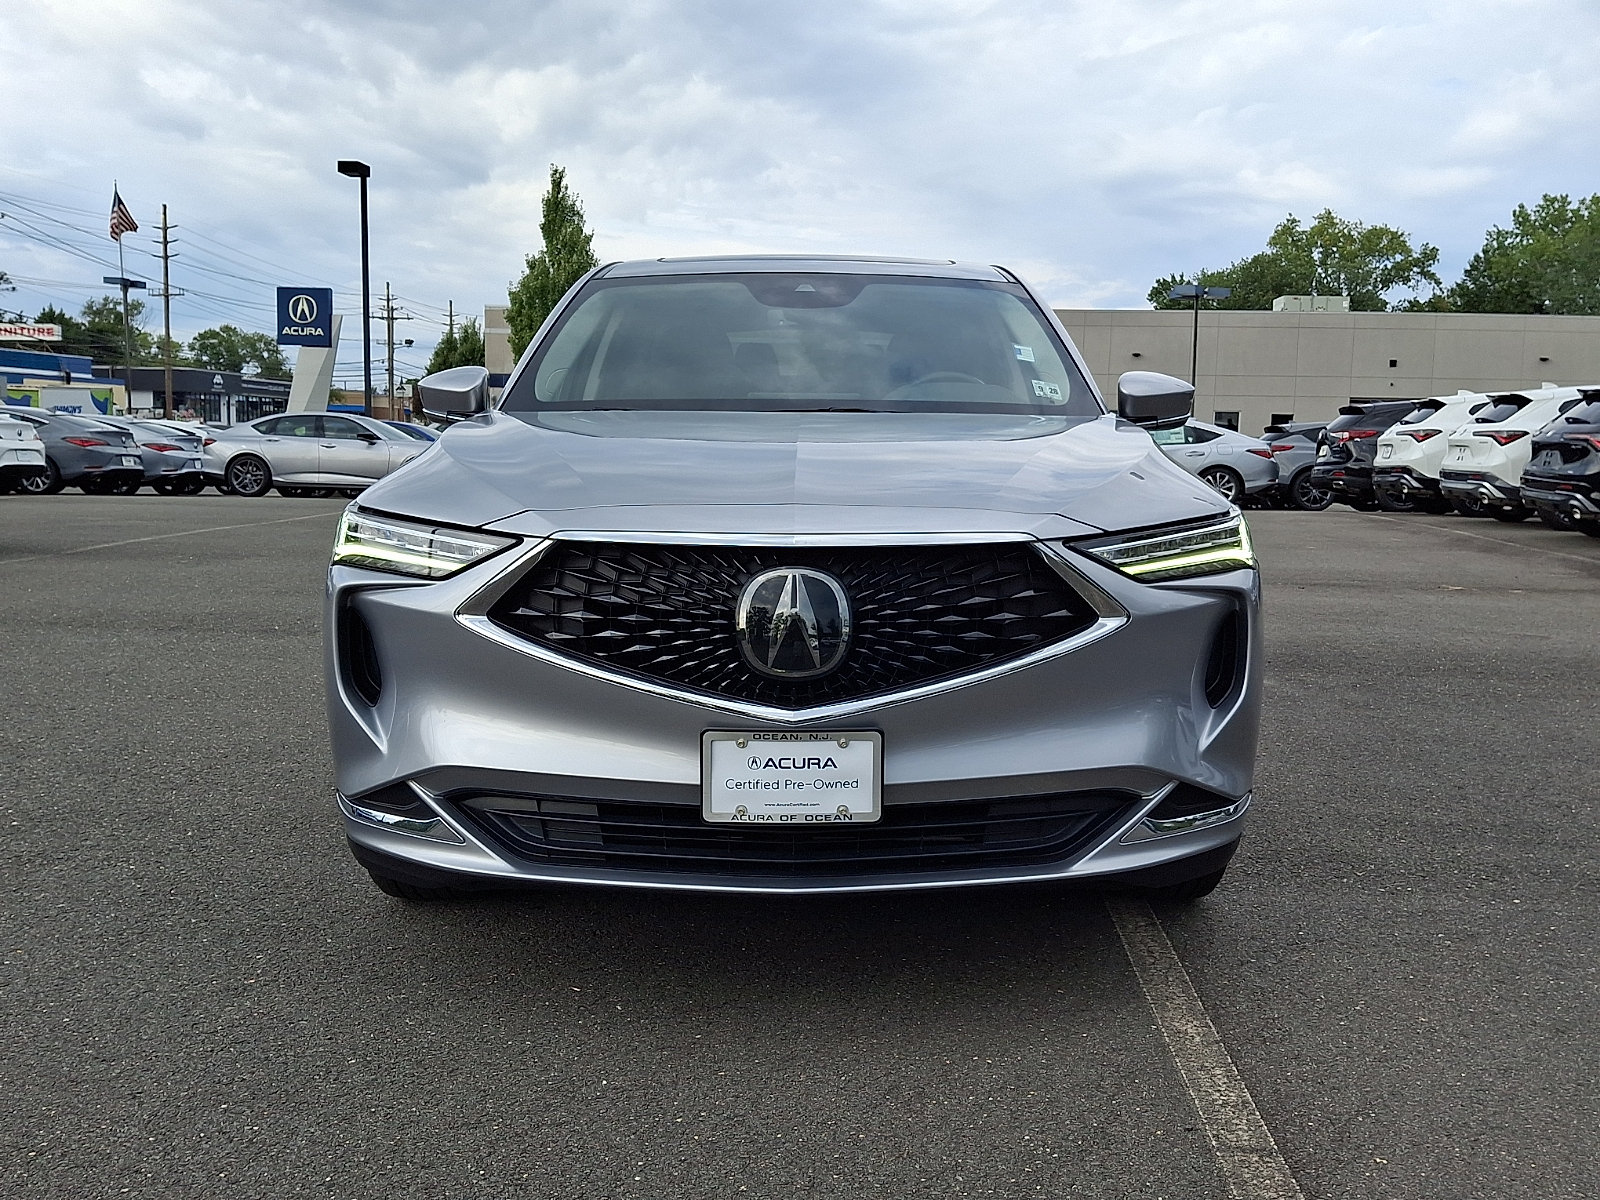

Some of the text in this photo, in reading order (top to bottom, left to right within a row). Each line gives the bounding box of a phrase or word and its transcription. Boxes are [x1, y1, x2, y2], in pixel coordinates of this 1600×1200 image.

[281, 326, 325, 336] ACURA
[752, 733, 833, 741] OCEAN, N.J.
[762, 757, 838, 770] ACURA
[725, 778, 859, 790] Certified Pre-Owned
[730, 813, 853, 822] ACURA OF OCEAN
